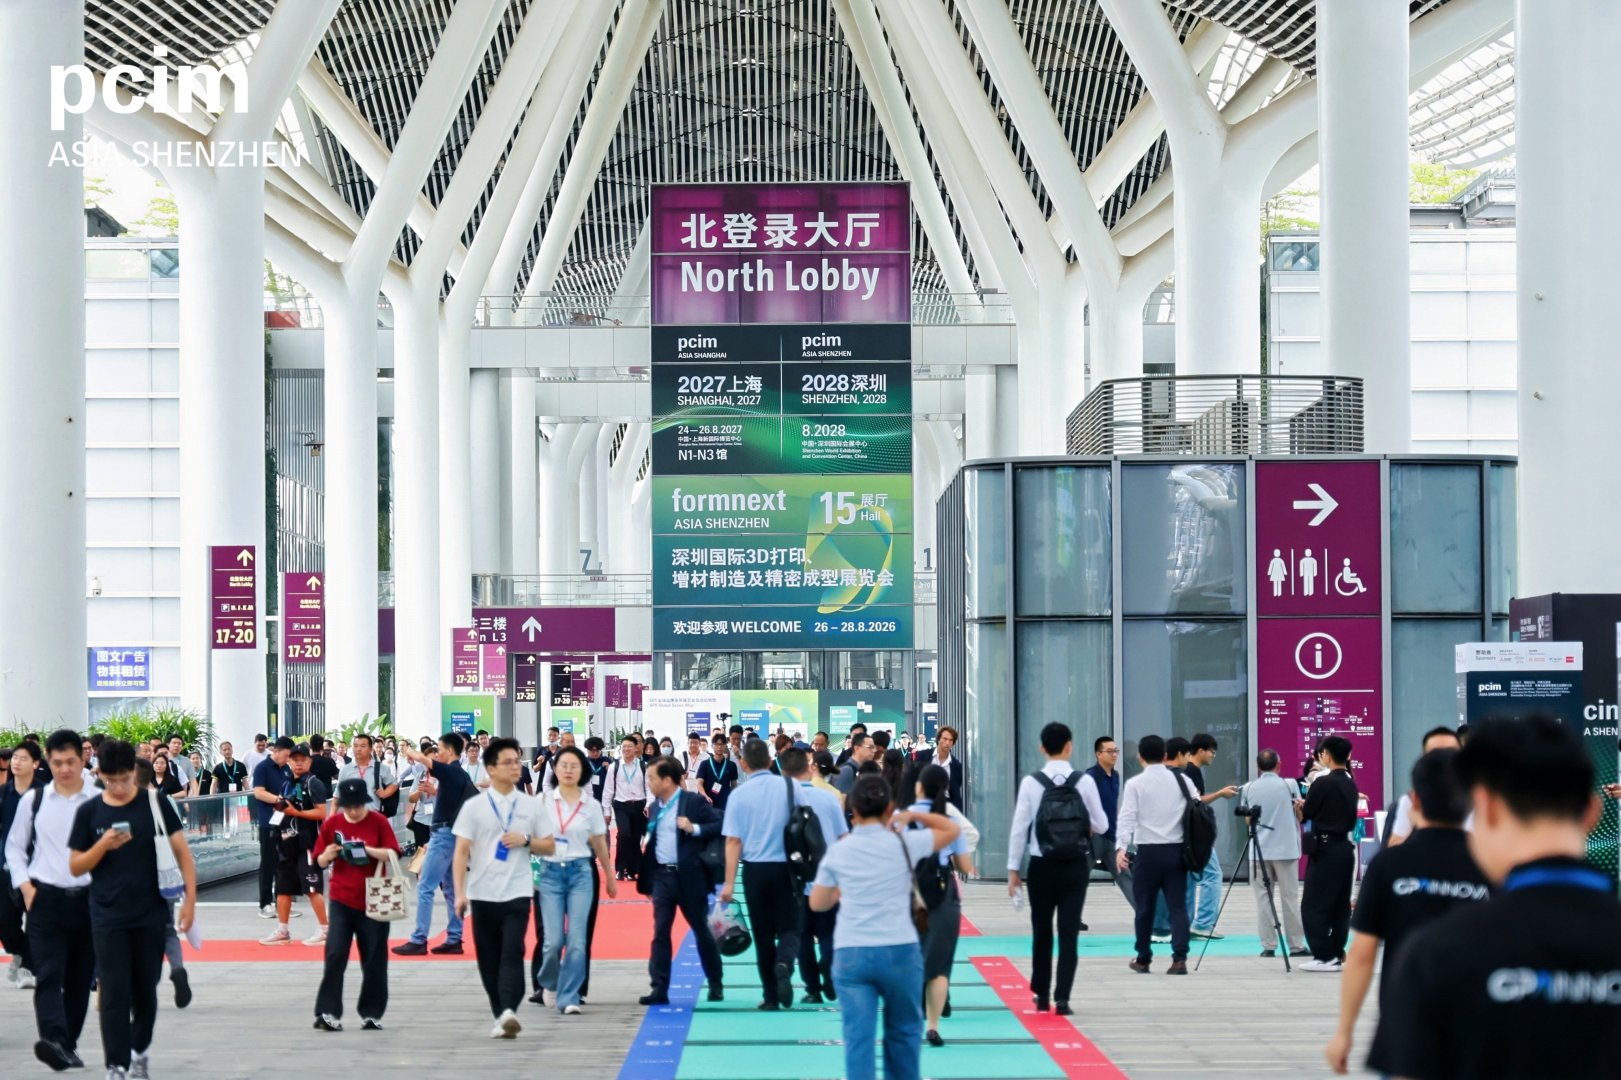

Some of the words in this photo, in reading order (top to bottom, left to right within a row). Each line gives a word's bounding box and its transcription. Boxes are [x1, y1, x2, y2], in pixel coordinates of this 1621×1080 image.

[681, 211, 880, 249] 北登录大厅
[681, 259, 774, 293] North
[785, 258, 880, 301] Lobby
[678, 334, 717, 351] pcim
[802, 333, 841, 351] pcim
[818, 350, 852, 358] SHENZHEN
[678, 375, 763, 394] 2027上海
[802, 373, 887, 393] 2028深圳
[678, 395, 735, 407] SHANGHAI,
[736, 395, 761, 406] 2027
[802, 394, 860, 405] SHENZHEN,
[862, 394, 887, 404] 2028
[802, 424, 846, 437] 8.2028
[678, 449, 714, 461] N1-N3
[716, 448, 728, 460] 馆
[672, 488, 787, 513] formnext
[861, 493, 889, 508] 展厅
[820, 491, 857, 525] 15
[861, 510, 881, 522] Hall
[674, 518, 703, 530] ASIA
[705, 517, 770, 529] SHENZHEN
[672, 568, 895, 589] 增材制造及精密成型展览会
[673, 620, 729, 636] 欢迎参观
[731, 620, 802, 634] WELCOME
[814, 622, 828, 633] 26
[840, 621, 897, 633] 28.8.2026
[215, 628, 254, 644] 17-20
[492, 632, 507, 642] L3
[96, 650, 146, 663] 图文广告
[287, 645, 321, 658] 17-20
[96, 665, 145, 678] 物料租赁
[456, 674, 478, 684] 17-20
[1478, 682, 1502, 692] pcim
[516, 692, 536, 700] 17-20
[1593, 727, 1618, 736] SHEN
